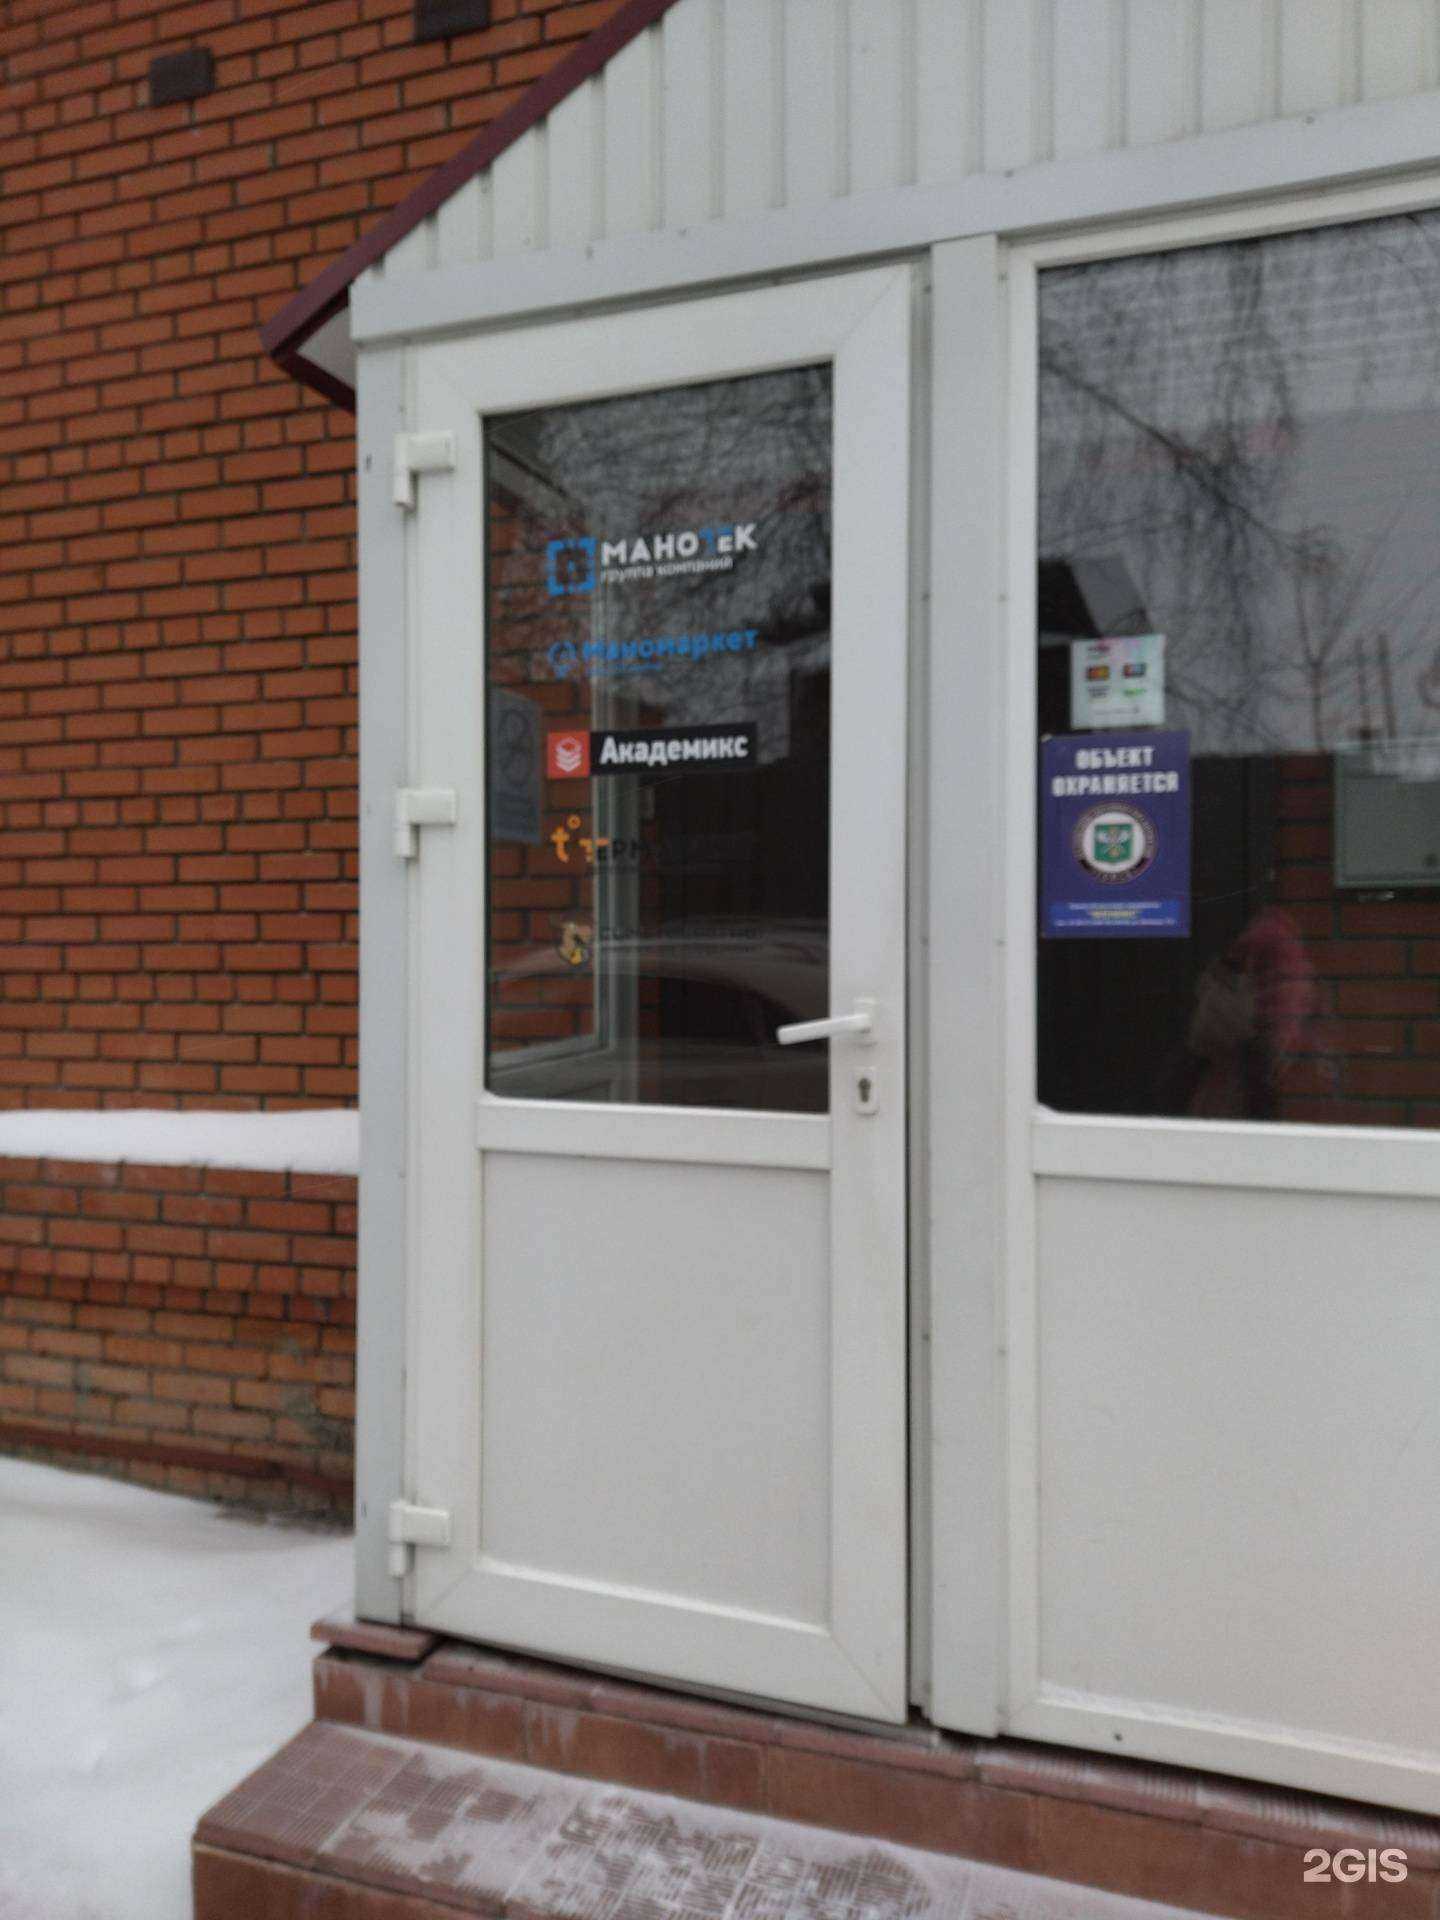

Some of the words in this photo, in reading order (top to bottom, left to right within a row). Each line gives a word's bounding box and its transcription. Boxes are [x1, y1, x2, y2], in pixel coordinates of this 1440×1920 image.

[599, 735, 750, 767] Академикс
[1074, 745, 1155, 771] ОБЪЕКТ
[1051, 771, 1179, 798] ОХРАНЯЕТСЯ
